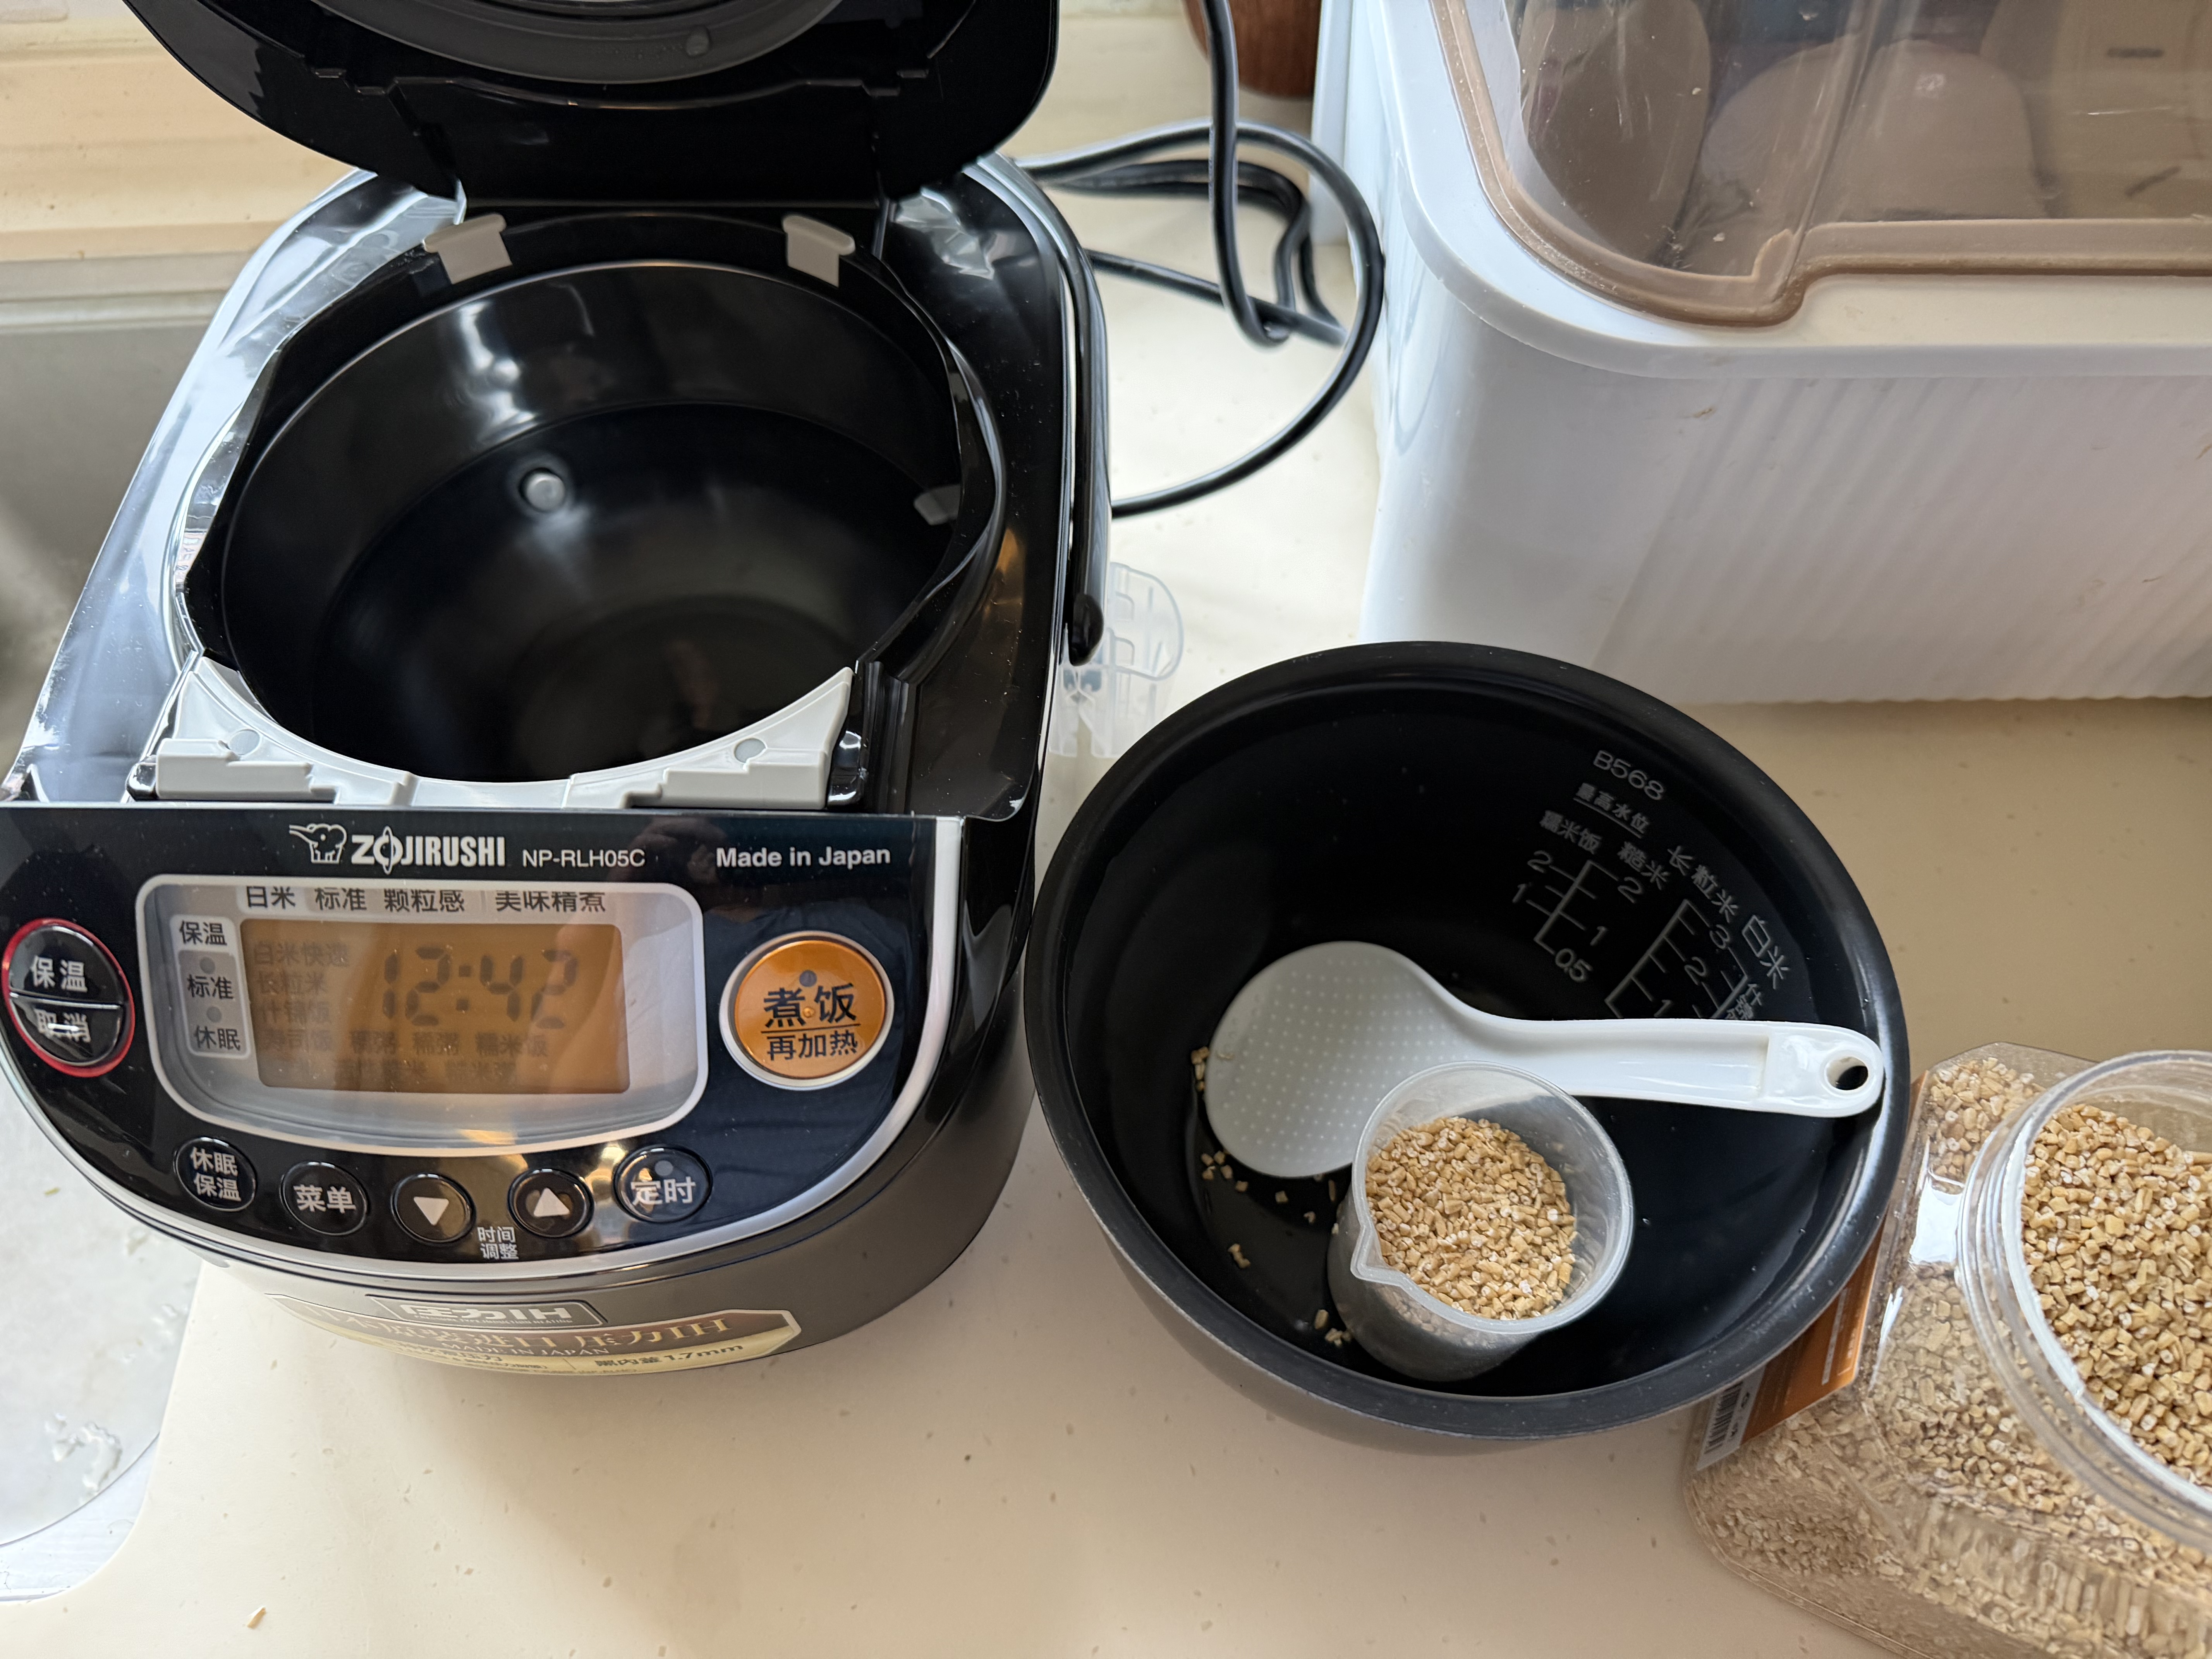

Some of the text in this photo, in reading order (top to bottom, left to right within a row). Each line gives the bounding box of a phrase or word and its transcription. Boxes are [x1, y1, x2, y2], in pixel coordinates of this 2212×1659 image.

[1593, 750, 1664, 800] B568
[1575, 782, 1650, 833] 最高水位
[351, 826, 505, 874] ZOJIRUSHI
[523, 849, 646, 868] NP-RLH05C
[716, 846, 891, 870] Made in Japan
[1527, 850, 1551, 873] 2
[1618, 876, 1645, 904] 2
[1667, 845, 1739, 923] 长粒米
[314, 888, 367, 911] 标准
[384, 888, 465, 913] 颗粒感
[179, 920, 228, 946] 保温
[1590, 926, 1608, 946] 1
[1741, 915, 1790, 990] 白米
[29, 955, 88, 993] 保温
[1684, 957, 1707, 985] 2
[187, 973, 234, 1000] 标准
[383, 946, 578, 1029] 12:42
[763, 983, 857, 1028] 煮饭
[194, 1025, 241, 1051] 休眠
[766, 1030, 859, 1061] 再加热
[189, 1147, 238, 1176] 休眠
[194, 1173, 242, 1201] 保温
[293, 1183, 356, 1214] 菜单
[630, 1176, 696, 1205] 定时
[477, 1226, 516, 1243] 时间
[480, 1243, 519, 1260] 调整
[441, 1343, 507, 1353] MADE
